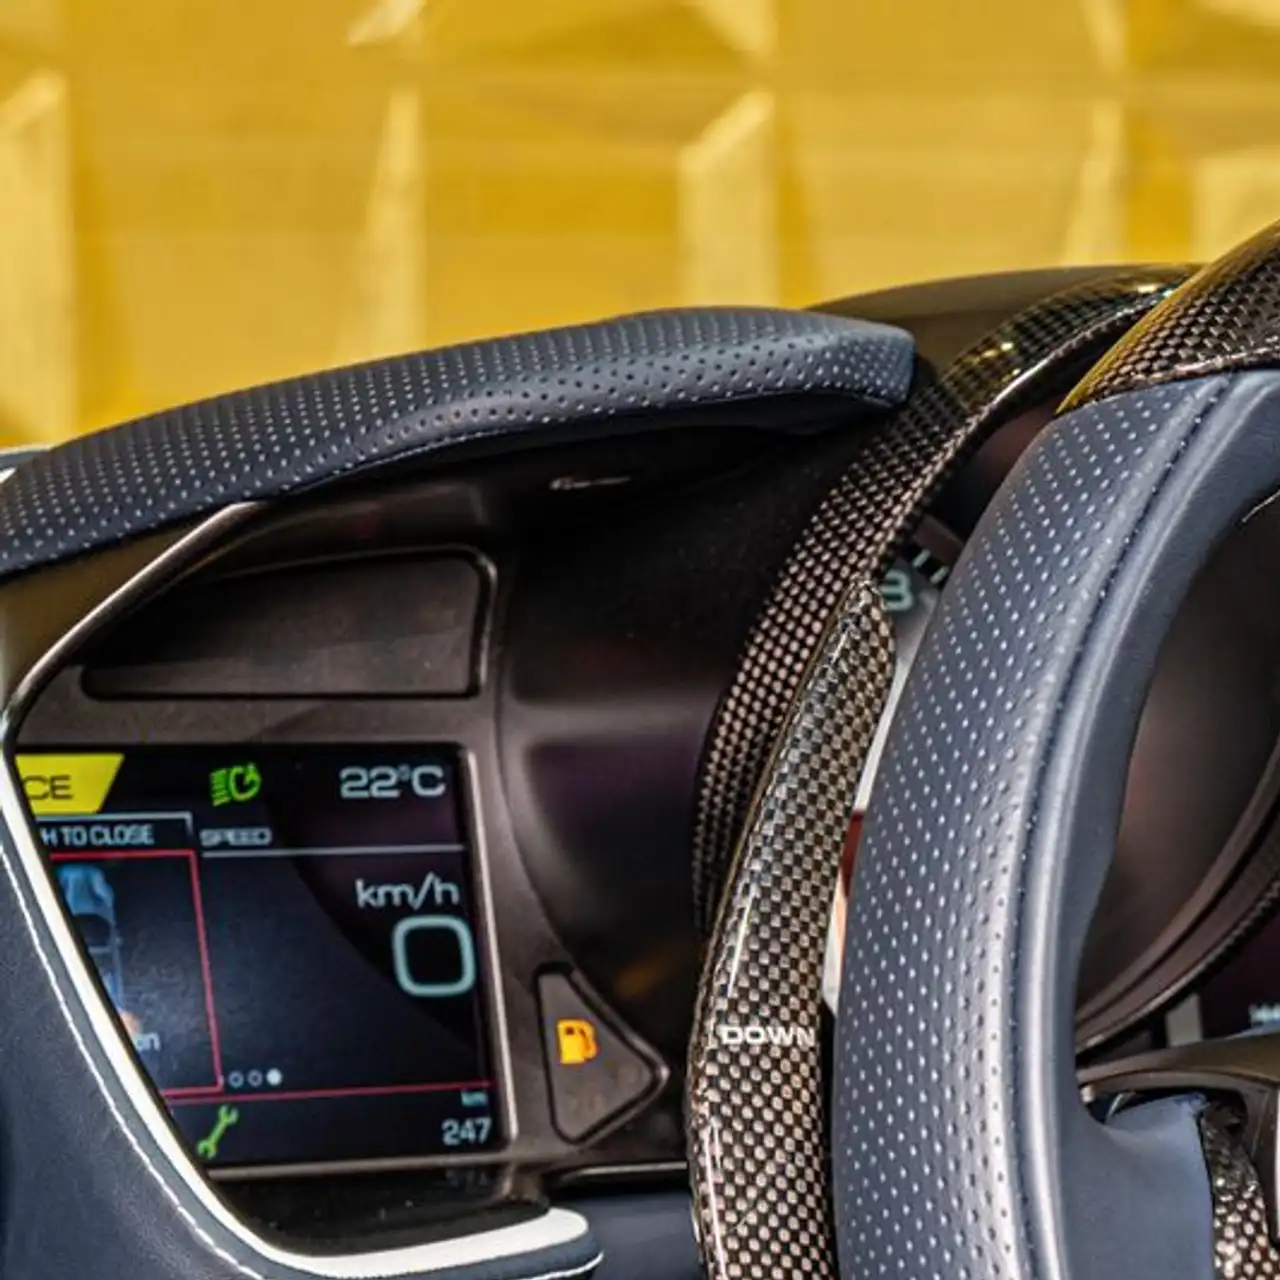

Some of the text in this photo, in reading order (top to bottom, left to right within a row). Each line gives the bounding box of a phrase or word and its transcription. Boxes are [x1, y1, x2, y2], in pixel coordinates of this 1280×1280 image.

[338, 763, 447, 799] 22°C
[90, 823, 155, 846] CLOSE
[355, 871, 461, 912] km/h
[719, 1025, 817, 1050] DOWN
[441, 1116, 493, 1146] 247
